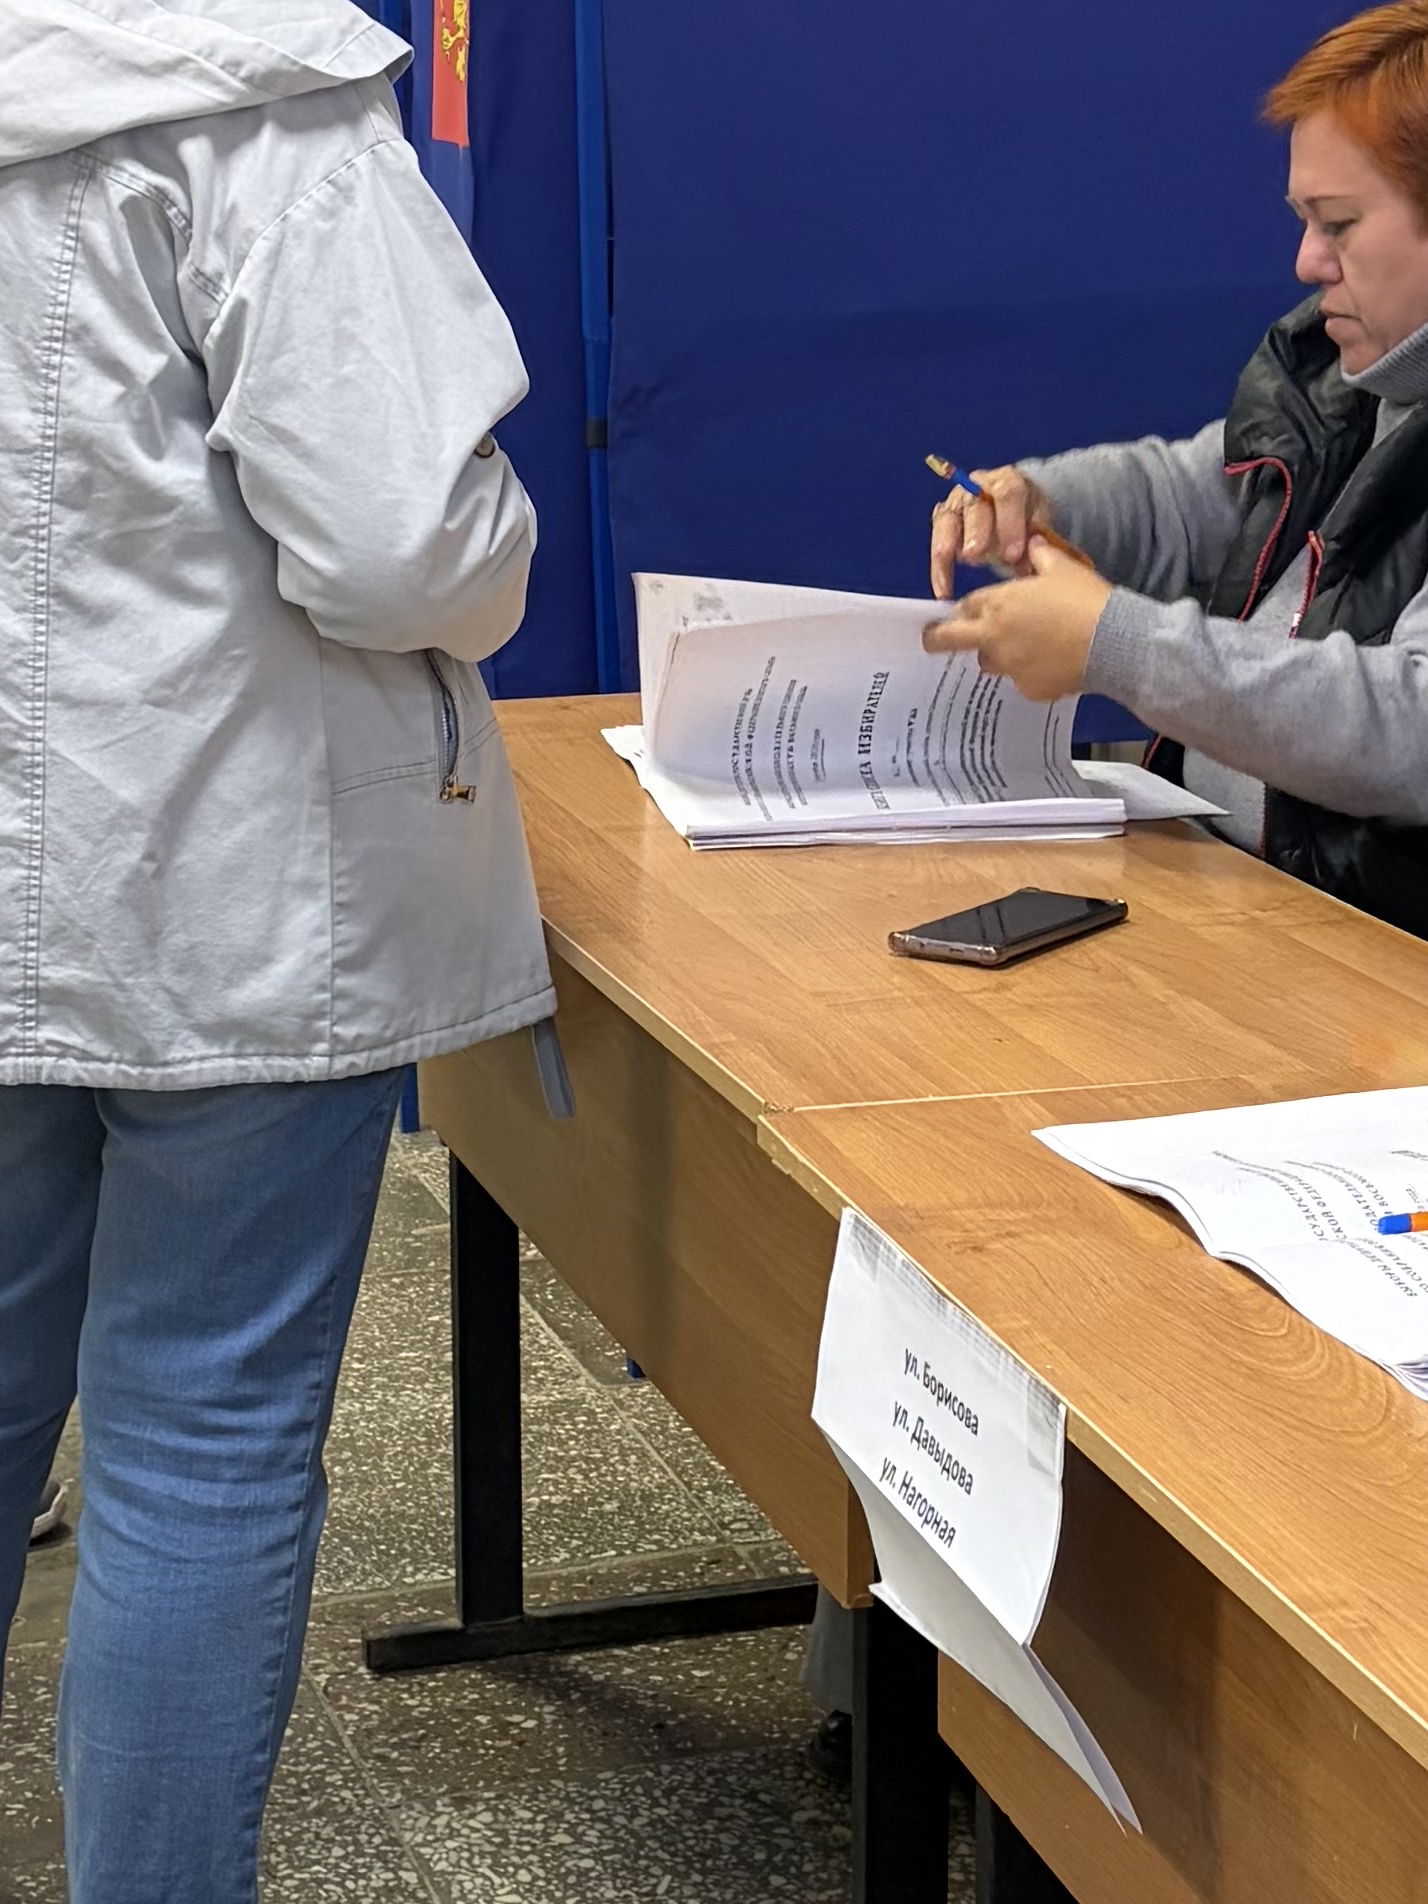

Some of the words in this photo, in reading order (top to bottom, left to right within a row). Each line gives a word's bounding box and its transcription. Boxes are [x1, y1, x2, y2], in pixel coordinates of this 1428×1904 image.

[857, 672, 889, 754] ИЗБИРАТЕЛЕЙ
[904, 1348, 920, 1380] ул.
[923, 1361, 979, 1436] Борисова
[892, 1400, 909, 1433] ул.
[910, 1416, 974, 1495] Давыдова
[879, 1456, 896, 1489] ул.
[898, 1470, 957, 1549] Нагорная
